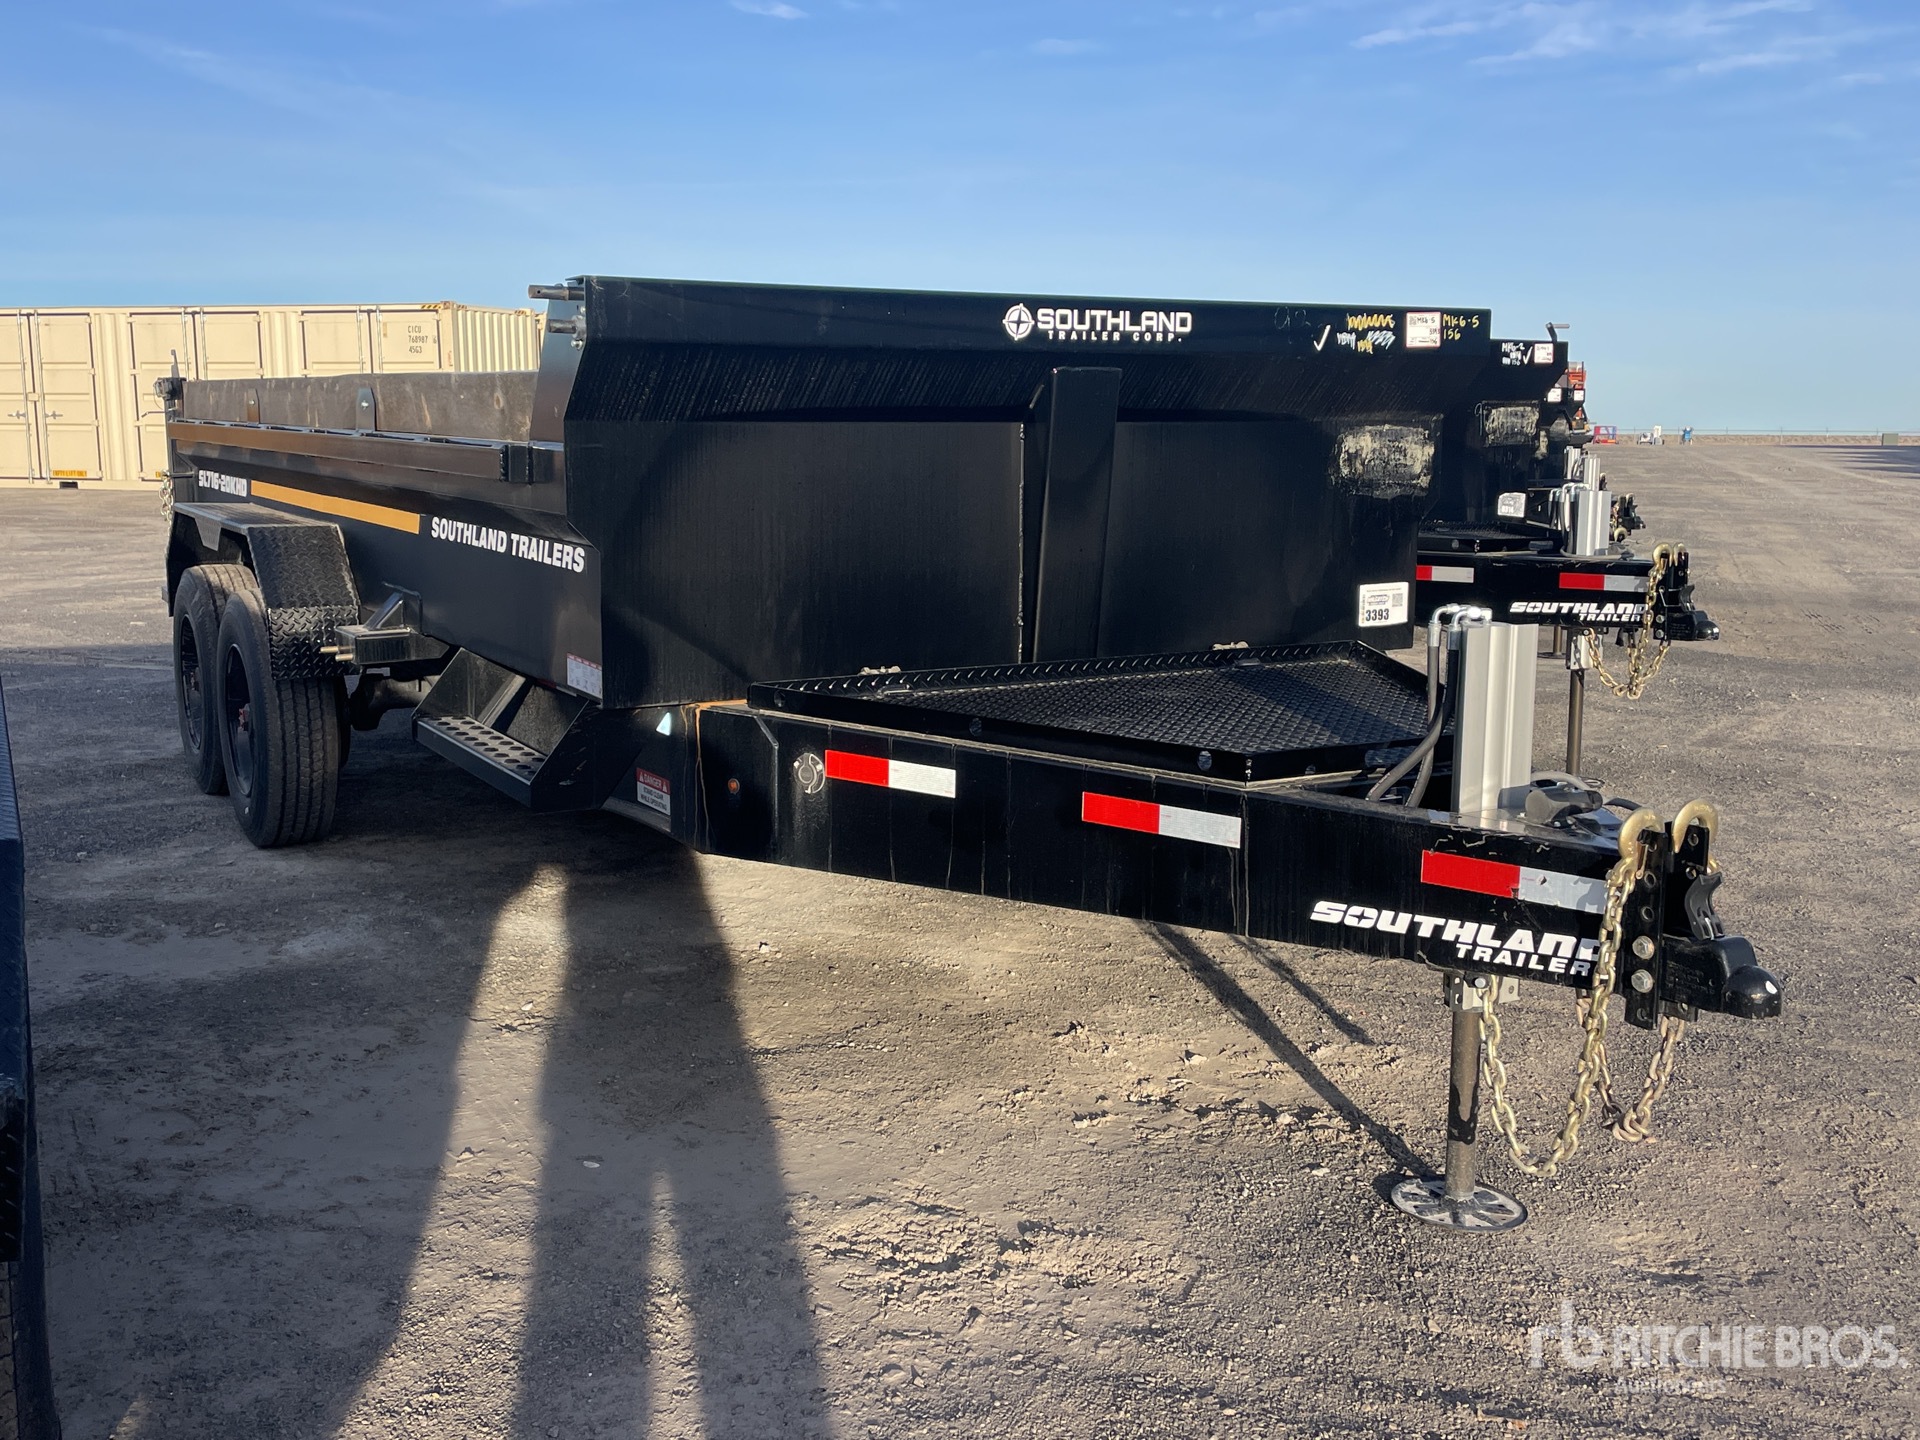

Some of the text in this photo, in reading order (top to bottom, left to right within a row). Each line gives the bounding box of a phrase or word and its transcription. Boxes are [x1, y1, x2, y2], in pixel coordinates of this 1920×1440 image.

[1037, 308, 1193, 333] SOUTHLAND
[407, 325, 422, 334] CICU
[1443, 328, 1461, 340] 156
[1048, 331, 1183, 342] TRAILER CORP.
[431, 516, 585, 573] SOUTHLAND TRAILERS
[1365, 608, 1390, 622] 3393
[1509, 602, 1649, 615] SOUTHLAND
